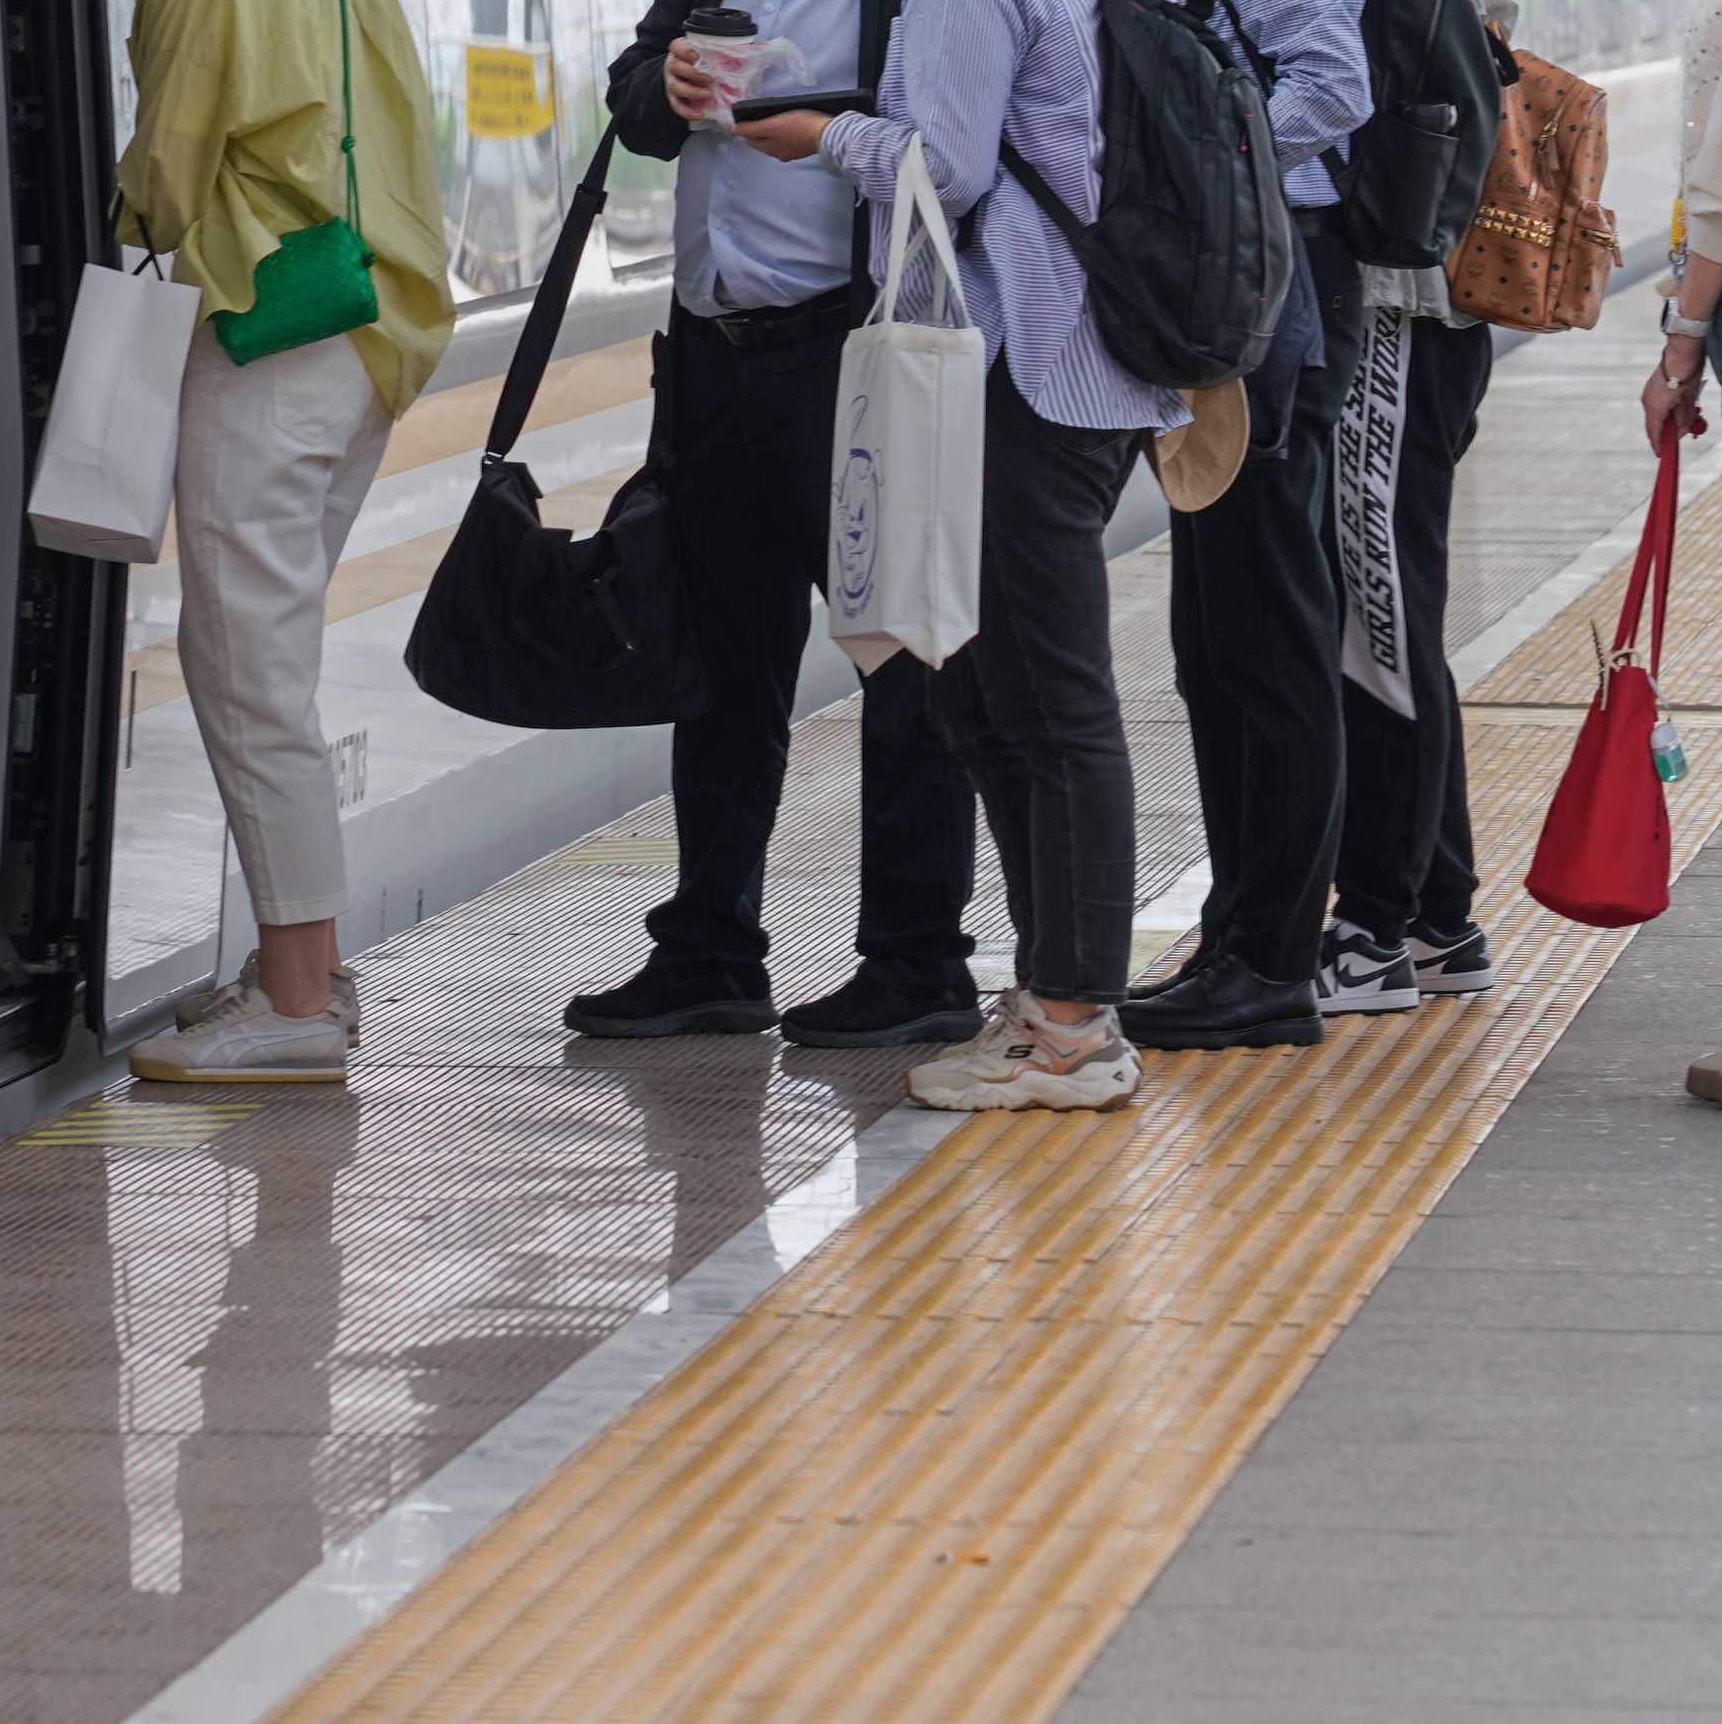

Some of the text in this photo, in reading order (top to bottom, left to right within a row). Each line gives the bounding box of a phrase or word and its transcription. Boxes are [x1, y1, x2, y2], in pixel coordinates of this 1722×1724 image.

[1339, 416, 1362, 497] THE
[1363, 306, 1402, 675] GIRLS RUN THE WORL
